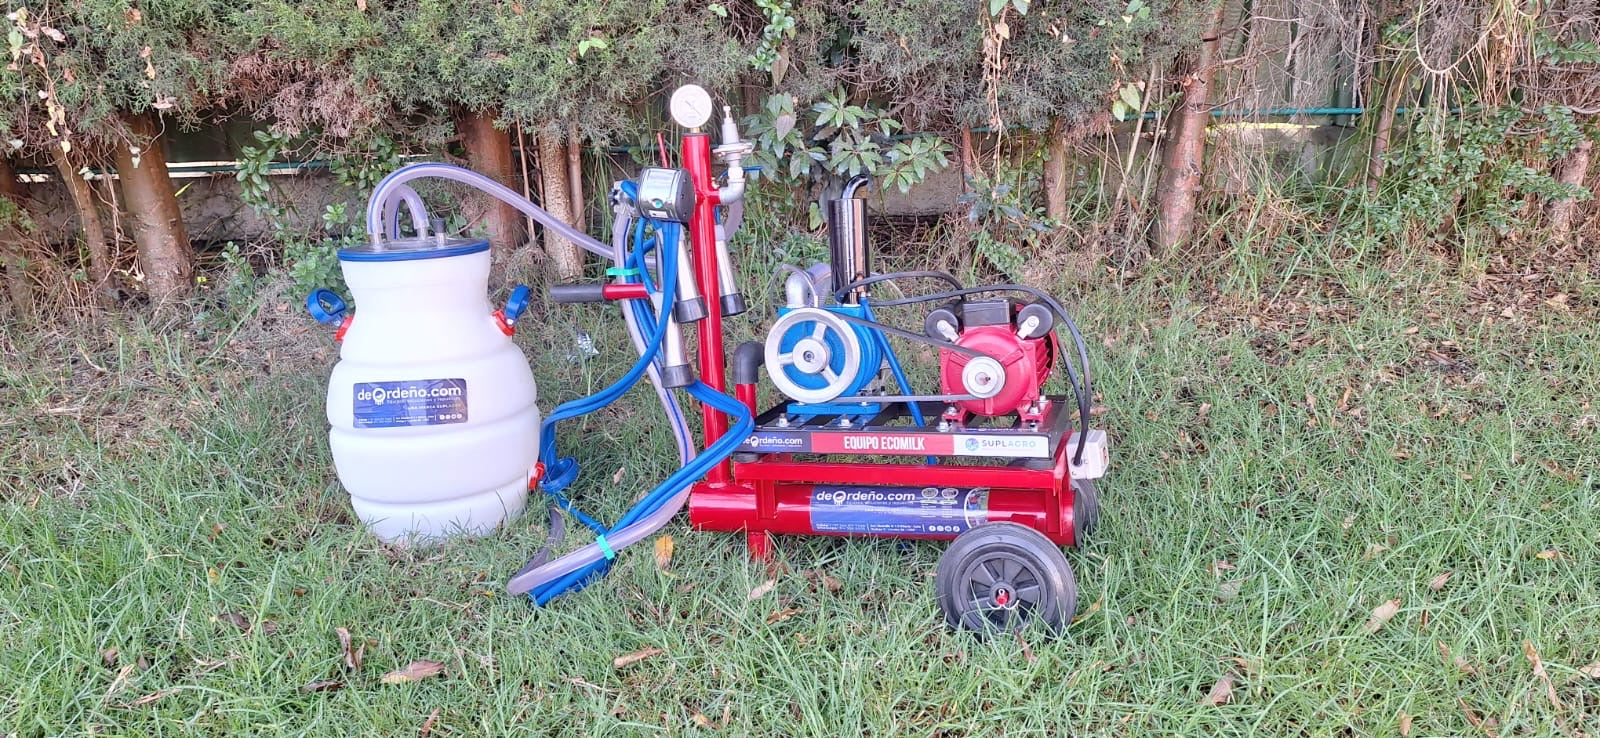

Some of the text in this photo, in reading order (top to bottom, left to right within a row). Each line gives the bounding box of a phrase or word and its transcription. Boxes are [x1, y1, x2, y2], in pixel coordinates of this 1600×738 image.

[844, 436, 925, 450] EQUIPO ECOMILK
[981, 439, 1036, 448] SUPLAGRO
